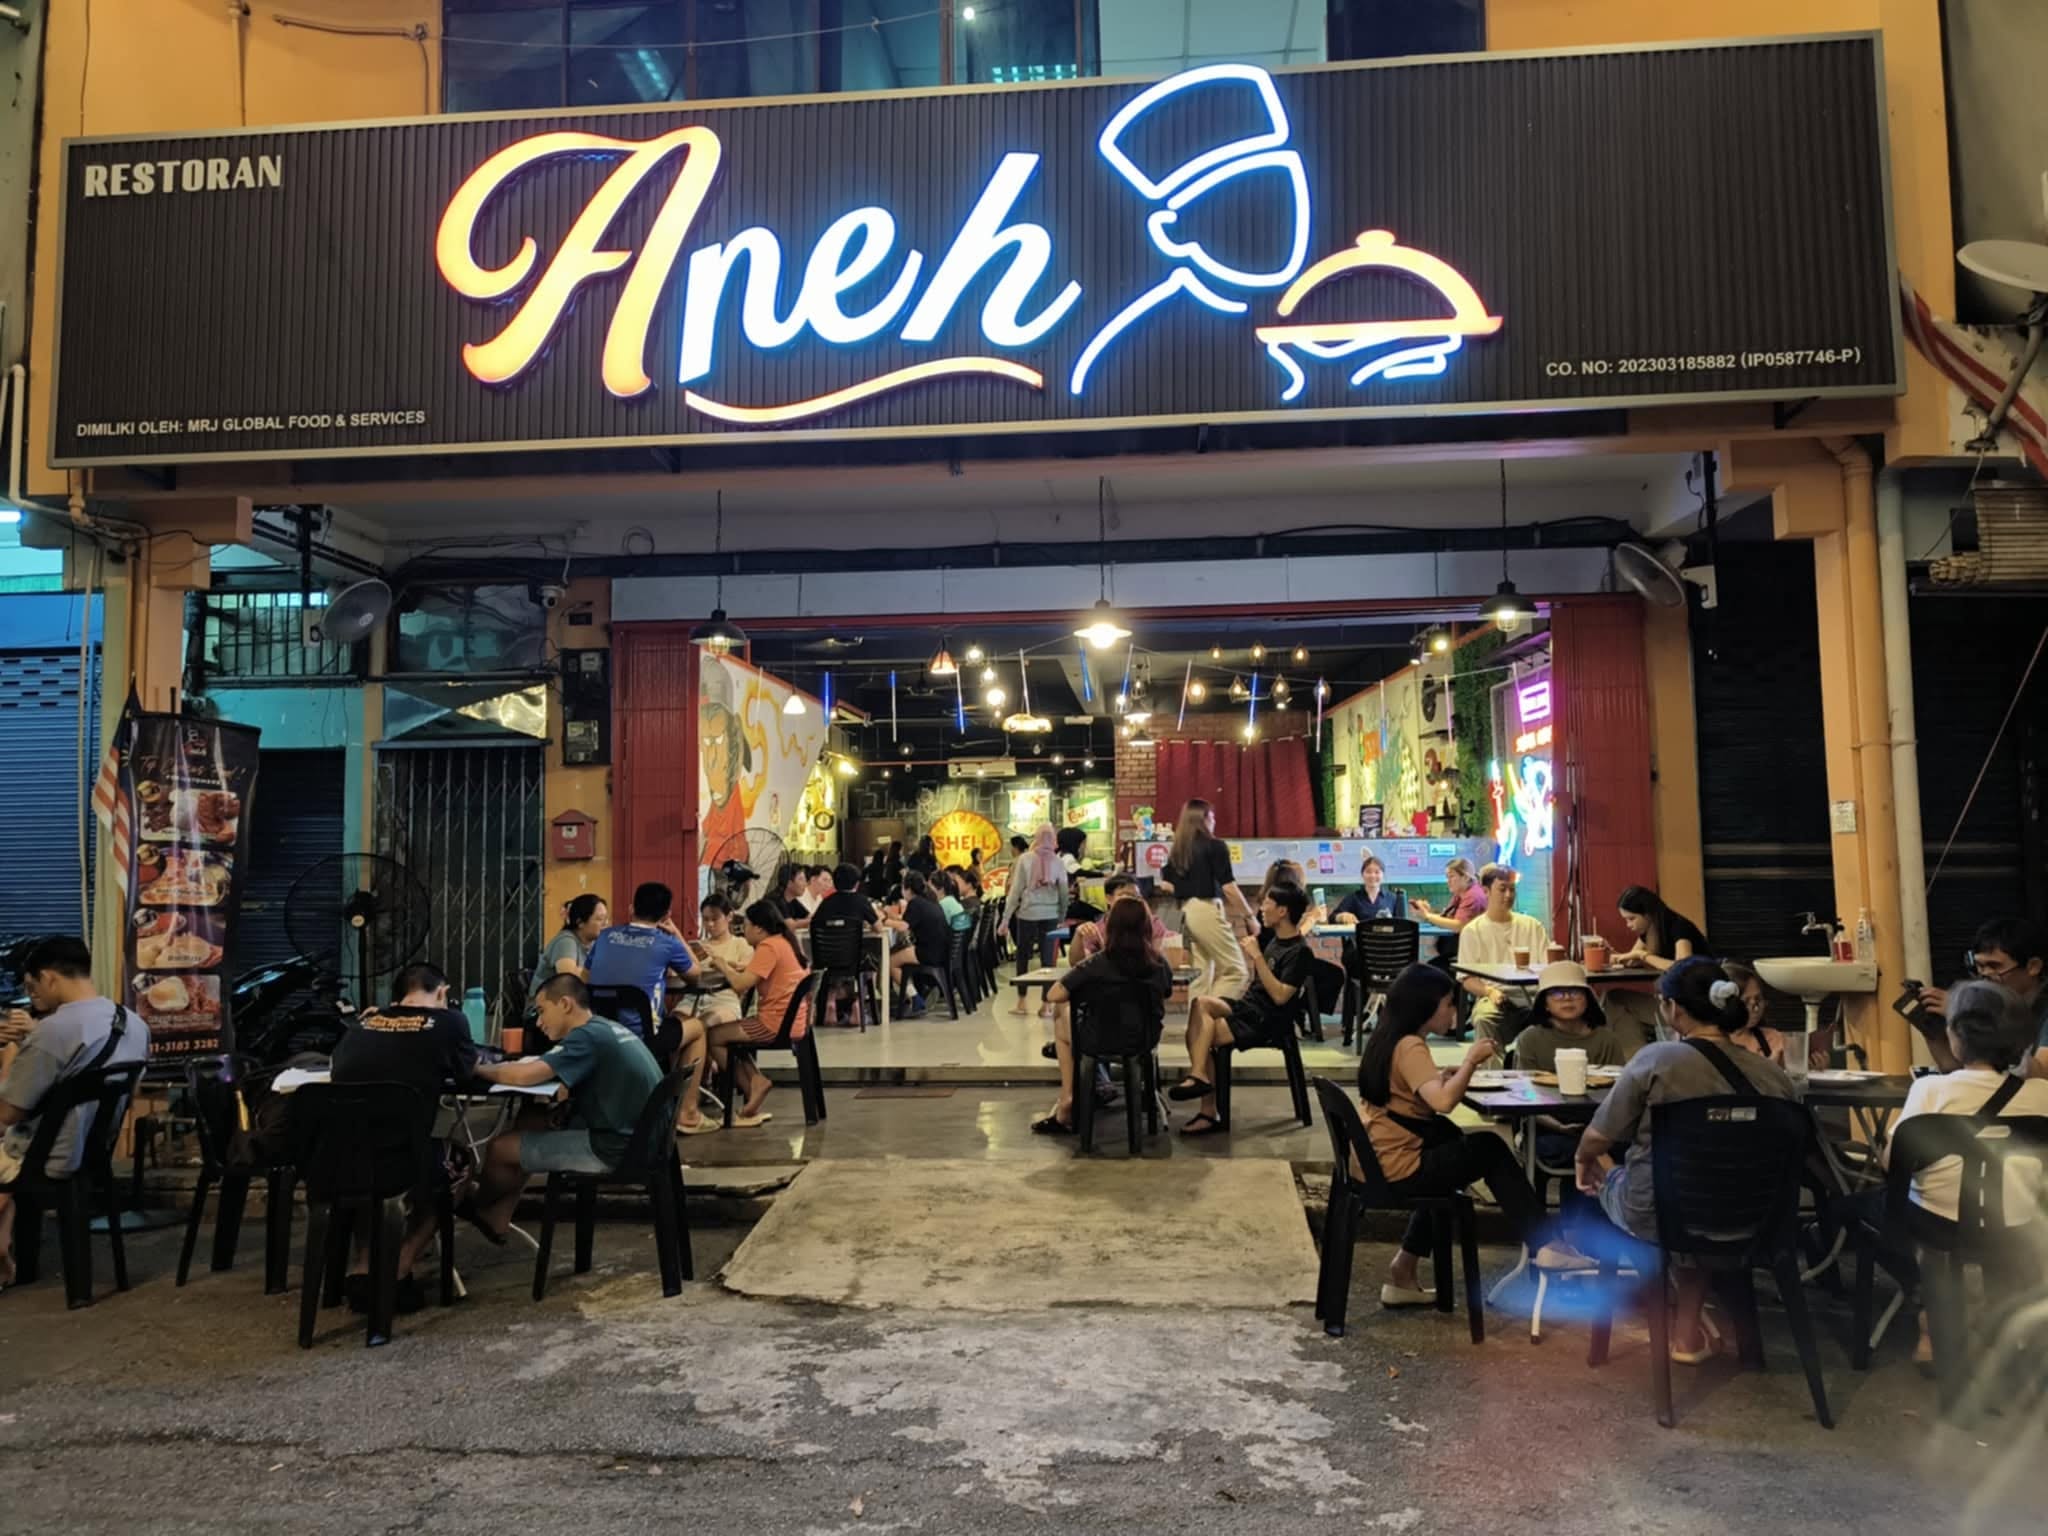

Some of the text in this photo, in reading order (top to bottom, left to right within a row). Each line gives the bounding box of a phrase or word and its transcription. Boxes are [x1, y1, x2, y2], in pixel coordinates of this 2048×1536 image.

[84, 155, 281, 197] RESTORAN
[436, 126, 1082, 396] Aneh
[1545, 346, 1861, 376] CO. NO: 202303185882 (IP0587746-P)
[76, 411, 426, 437] DIMILIKI OLEH: MRJ GLOBAL FOOD & SERVICES
[935, 835, 990, 850] SHELL
